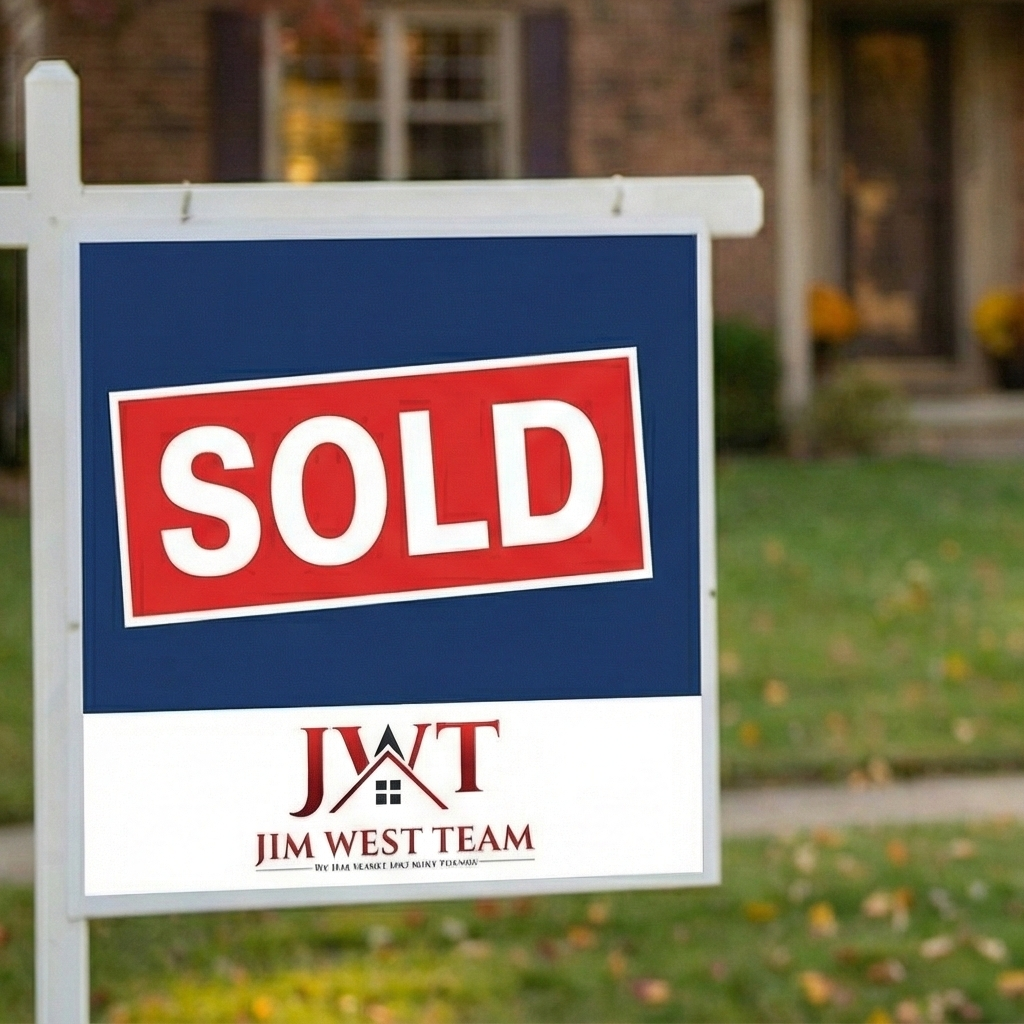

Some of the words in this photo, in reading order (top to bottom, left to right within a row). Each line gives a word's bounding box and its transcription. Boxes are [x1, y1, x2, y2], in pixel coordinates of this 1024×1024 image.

[159, 399, 604, 578] SOLD
[289, 719, 501, 817] JWT
[255, 832, 315, 867] JIM
[324, 827, 423, 858] WEST
[432, 824, 535, 853] TEAM
